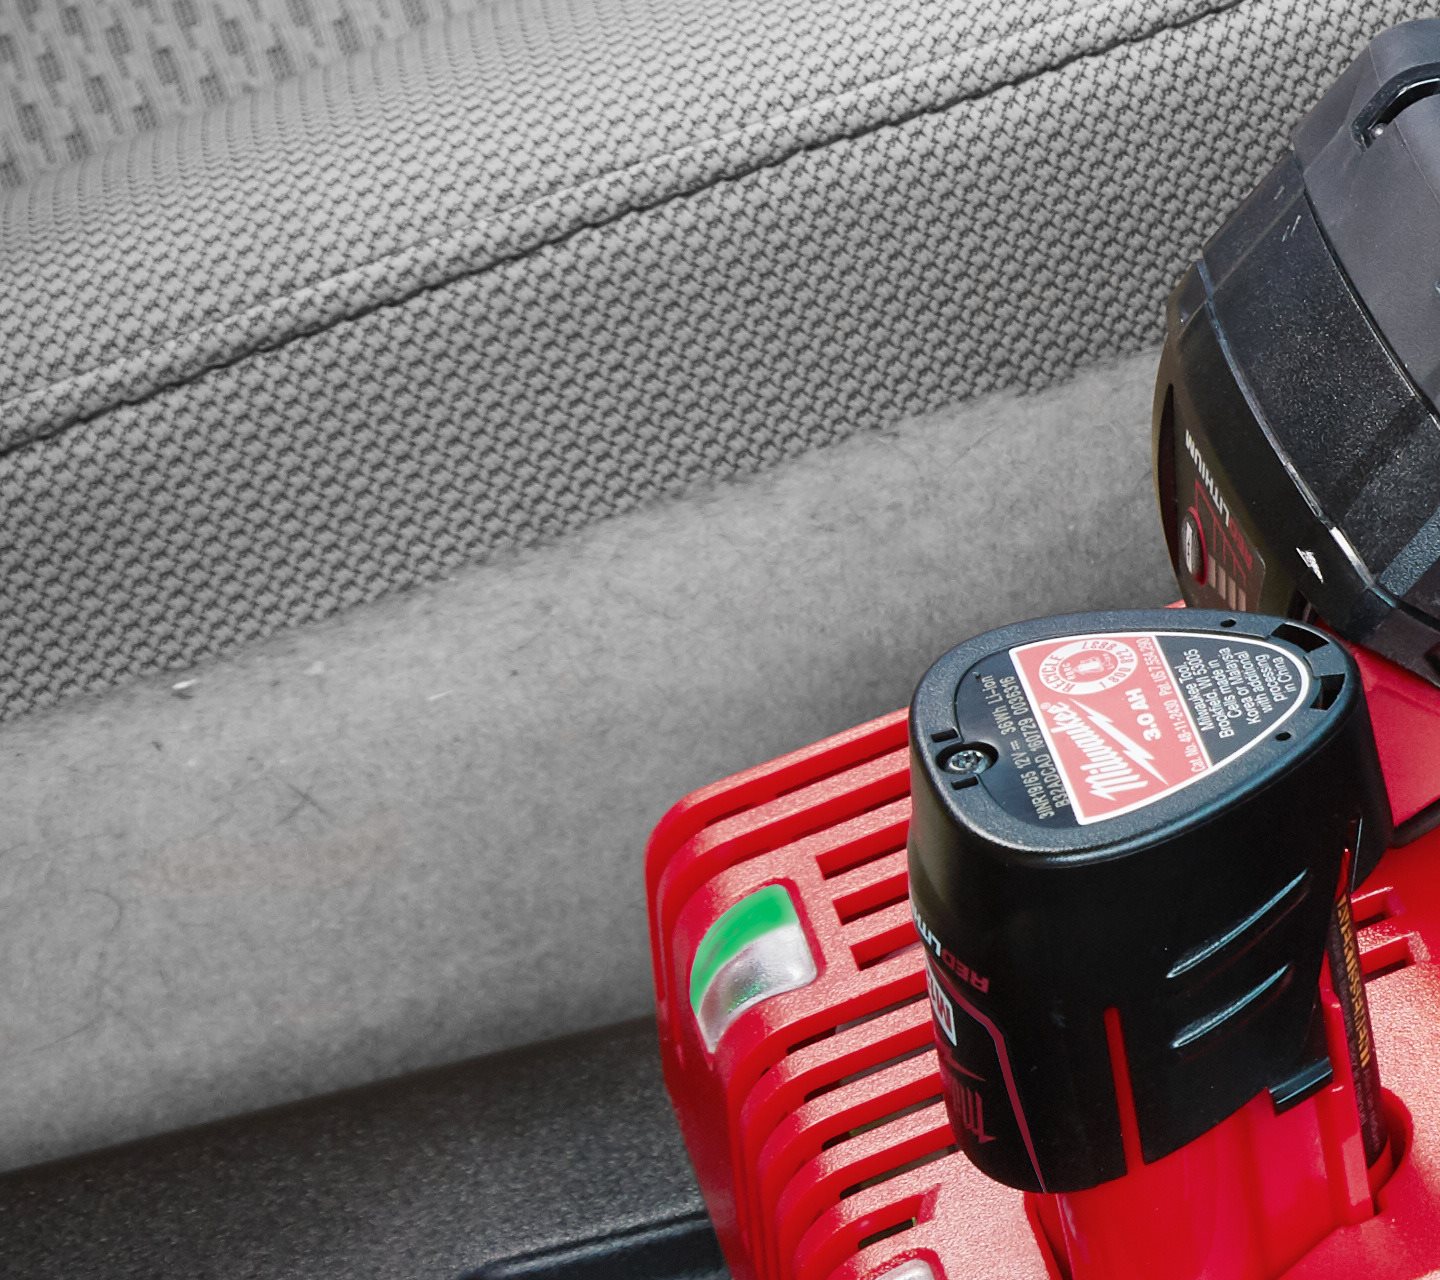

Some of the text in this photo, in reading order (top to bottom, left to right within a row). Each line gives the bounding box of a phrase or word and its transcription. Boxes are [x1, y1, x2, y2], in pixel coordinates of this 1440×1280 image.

[1035, 655, 1074, 694] RECYCLE
[1183, 648, 1207, 675] 53005
[1234, 650, 1272, 712] with additional
[1255, 654, 1287, 701] processing
[1272, 656, 1296, 692] in China
[981, 675, 1002, 703] Li-ion
[999, 676, 1027, 714] 0036316
[1196, 675, 1212, 689] WI
[1207, 659, 1242, 717] Cells made in
[1219, 647, 1260, 723] Korea or Malaysia
[992, 705, 1016, 734] 36Wh
[1125, 688, 1160, 740] 3.0 AH
[1186, 683, 1213, 730] Milwaukee
[1018, 717, 1043, 751] 160729
[1021, 771, 1054, 818] 3INR19/65
